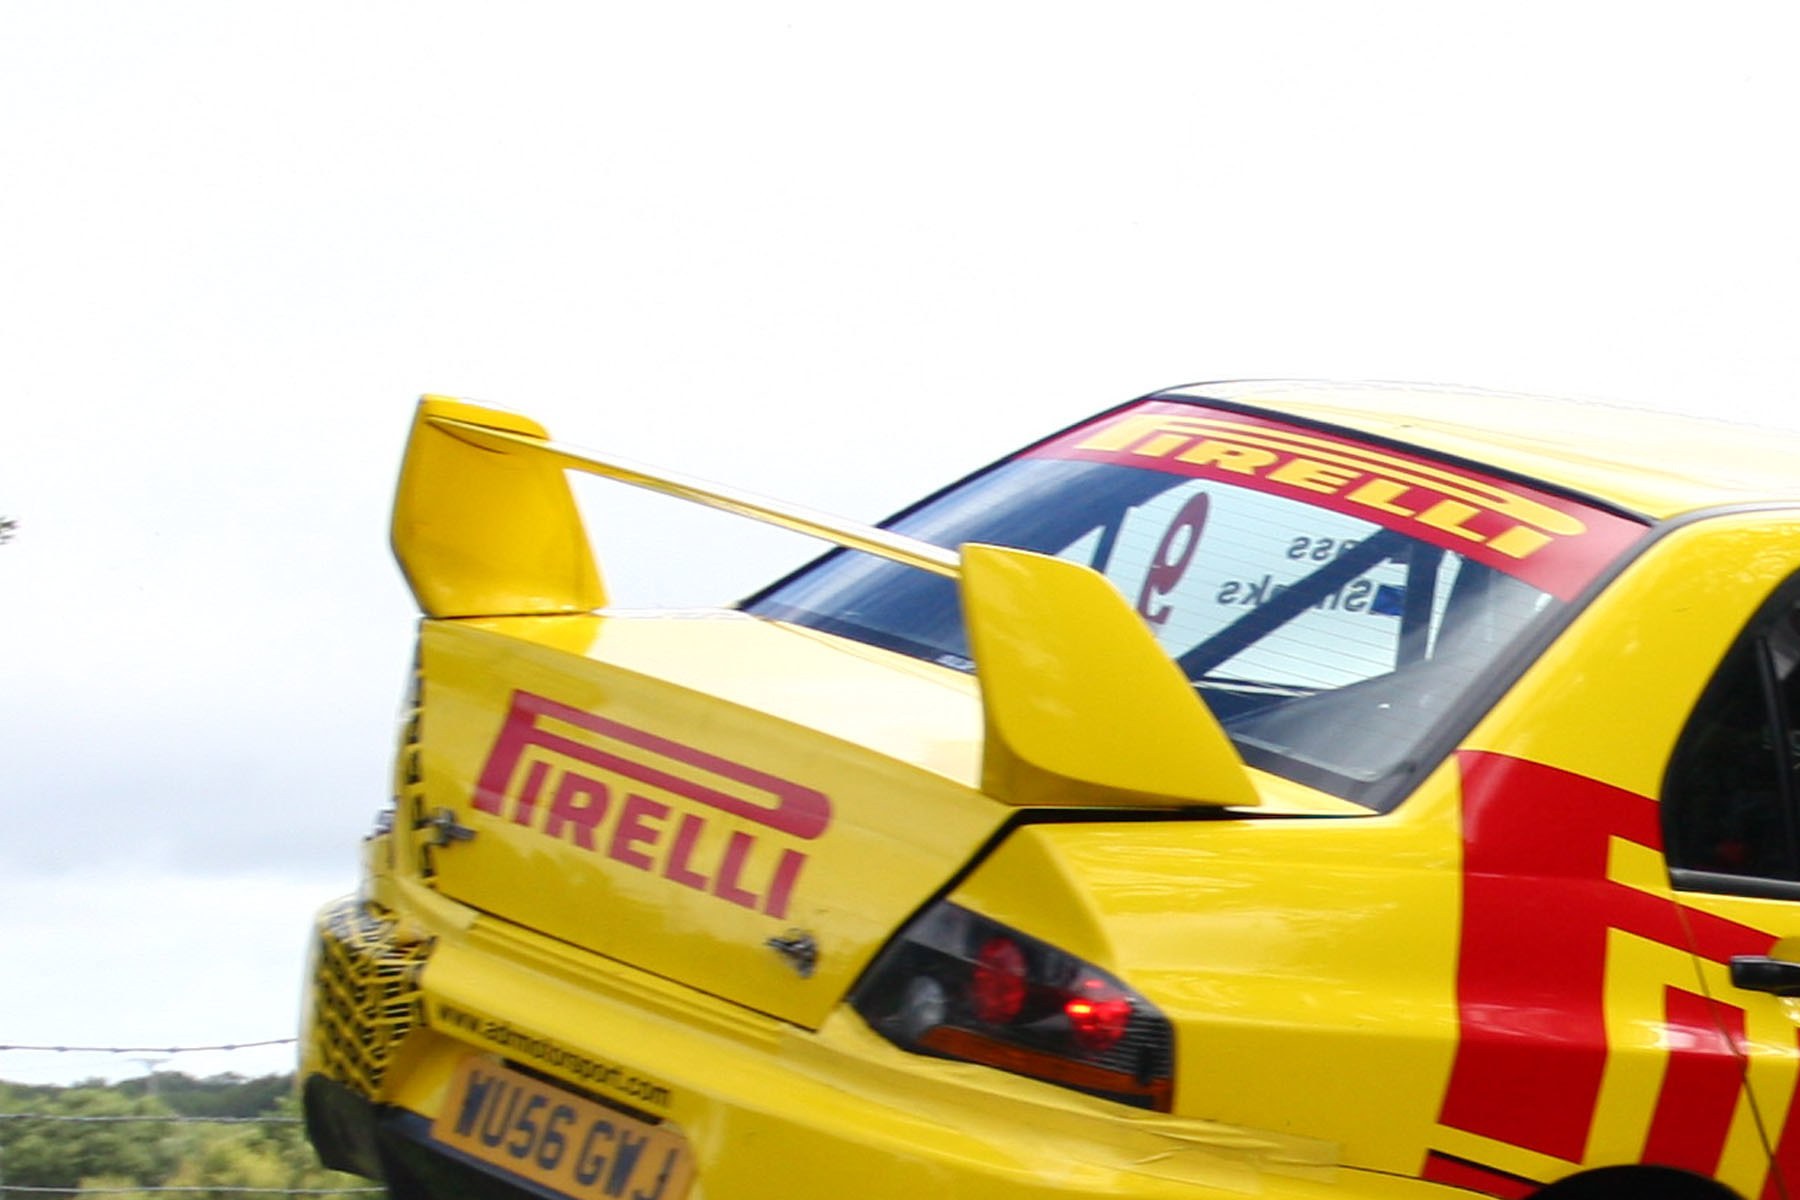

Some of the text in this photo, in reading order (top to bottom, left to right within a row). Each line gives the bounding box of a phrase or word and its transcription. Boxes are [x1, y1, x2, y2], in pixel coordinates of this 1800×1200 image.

[1073, 413, 1588, 559] PIRELLI
[470, 688, 833, 921] PIRELLI
[455, 1068, 577, 1171] WU56
